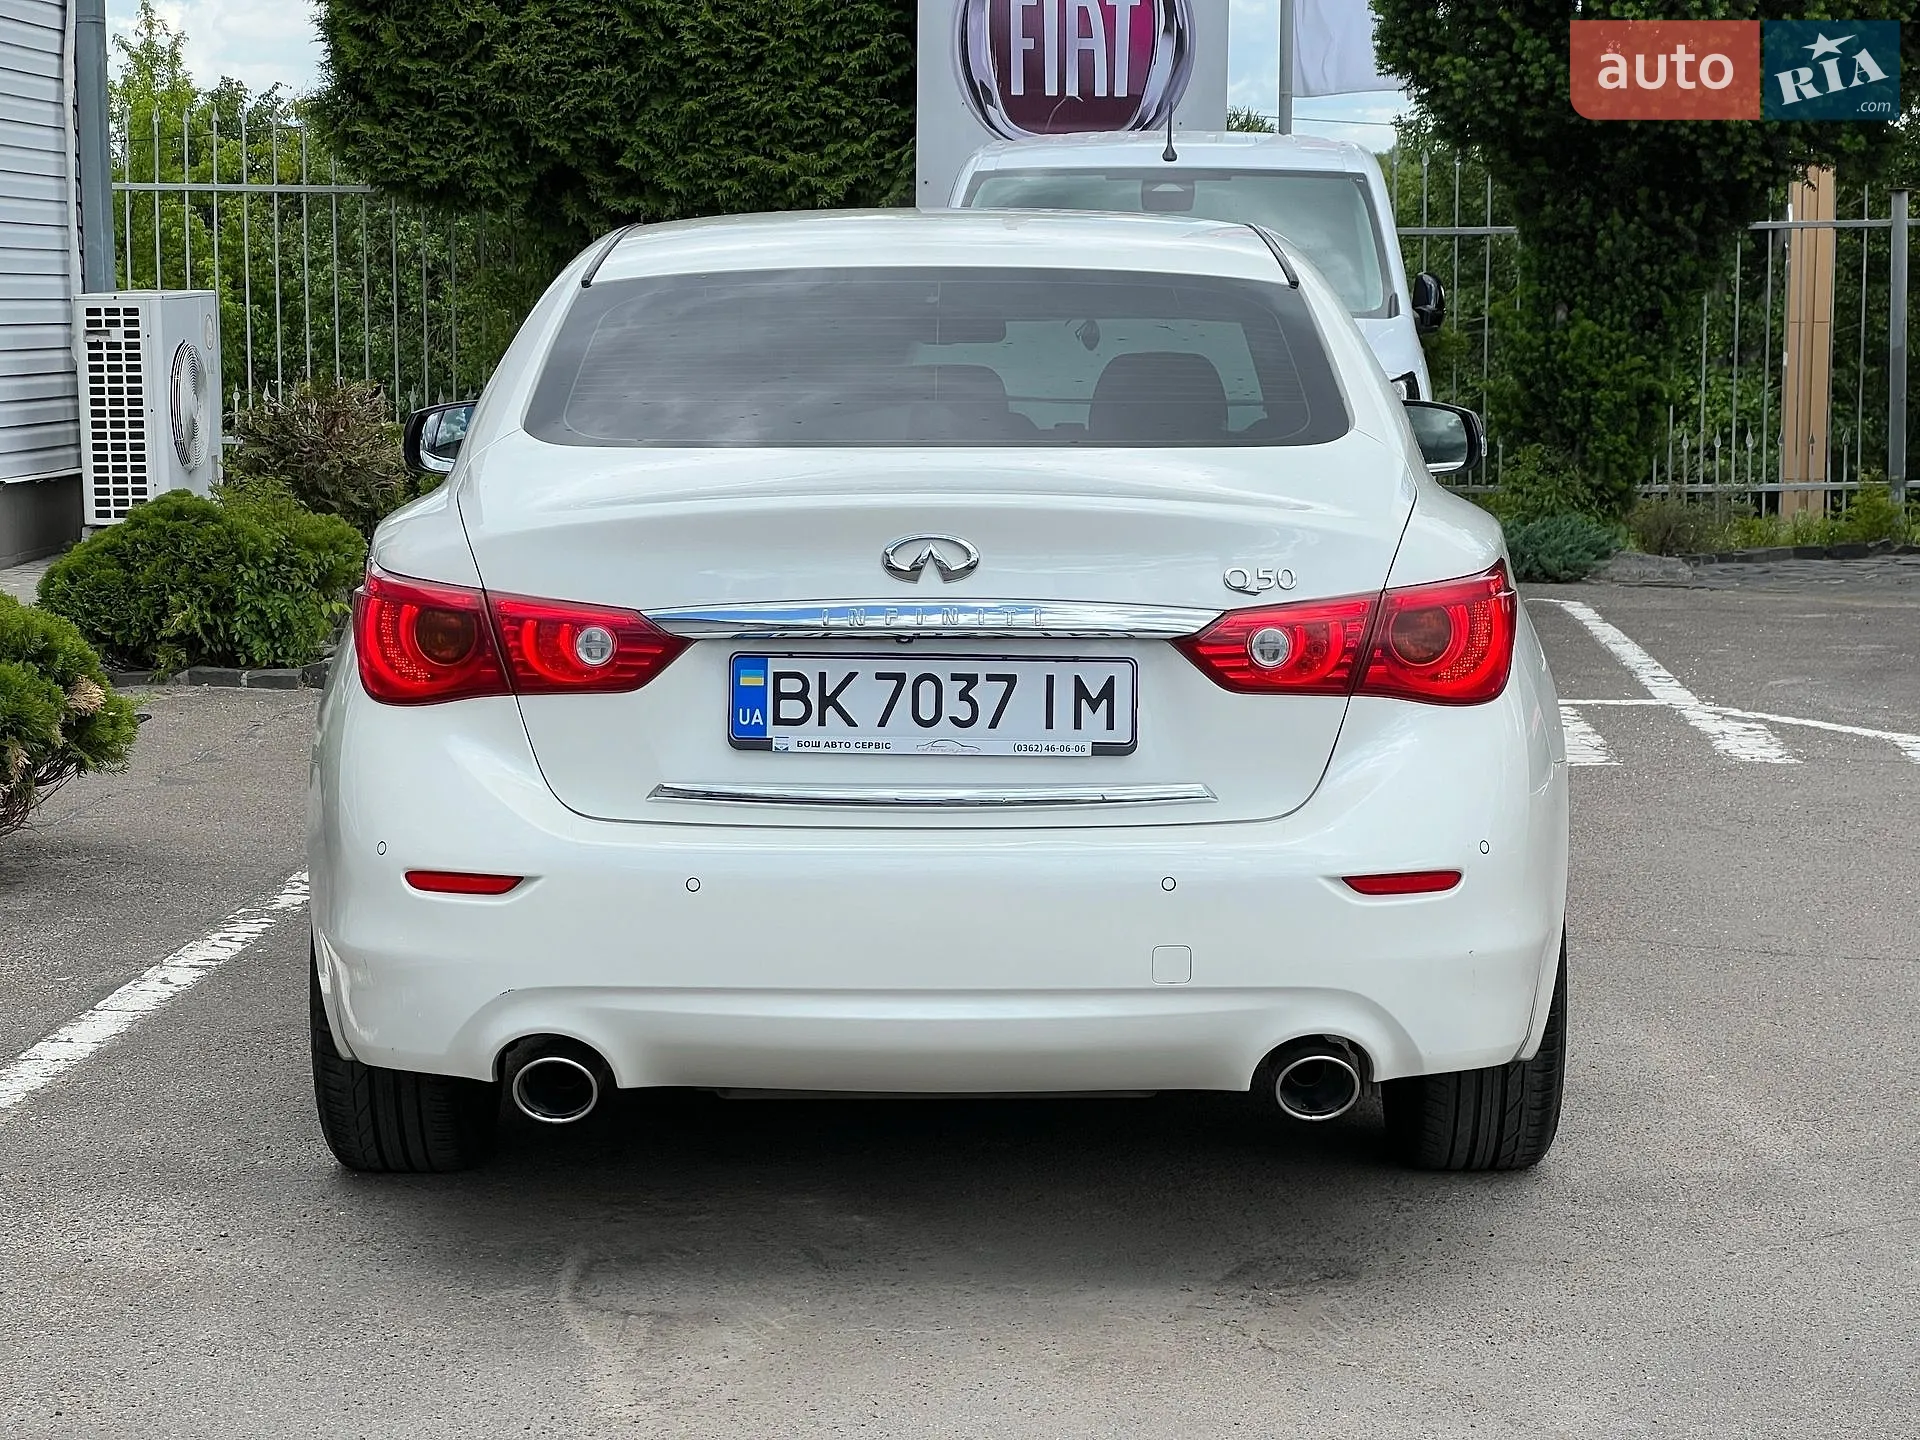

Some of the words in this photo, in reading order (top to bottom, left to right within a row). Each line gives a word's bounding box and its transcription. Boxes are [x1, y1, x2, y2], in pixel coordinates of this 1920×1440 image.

[1010, 0, 1141, 97] FIAT
[1223, 567, 1297, 596] Q50
[821, 608, 1044, 627] INFINITI
[772, 671, 859, 728] BK
[875, 672, 1017, 730] 7037
[1044, 674, 1116, 731] IM
[739, 708, 764, 726] UA
[797, 740, 820, 749] БОШ
[824, 740, 851, 750] АВТО
[855, 741, 892, 751] СЕРВІС
